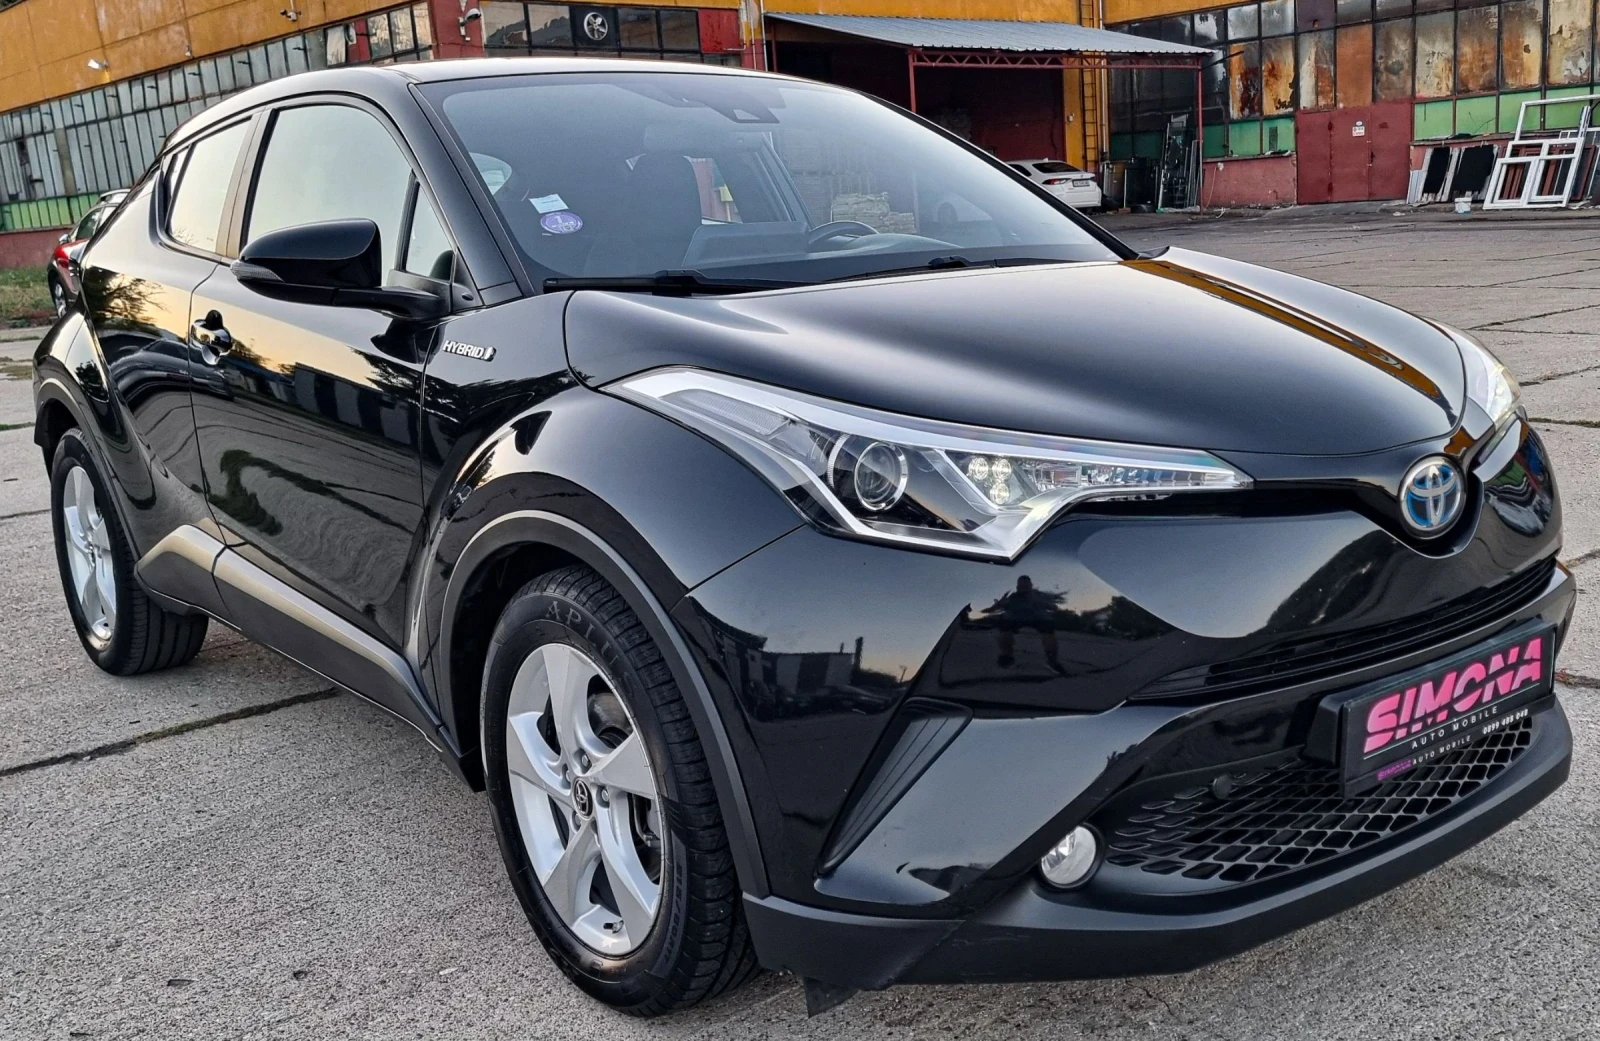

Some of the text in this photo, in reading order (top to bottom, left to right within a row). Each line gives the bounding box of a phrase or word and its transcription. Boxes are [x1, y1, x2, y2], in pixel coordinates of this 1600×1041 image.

[442, 340, 484, 359] HYBRID
[1363, 637, 1542, 754] SIMONA
[1411, 706, 1498, 749] AUTO MOBILE
[1412, 751, 1435, 766] AUTO
[1439, 735, 1471, 754] MOBILE
